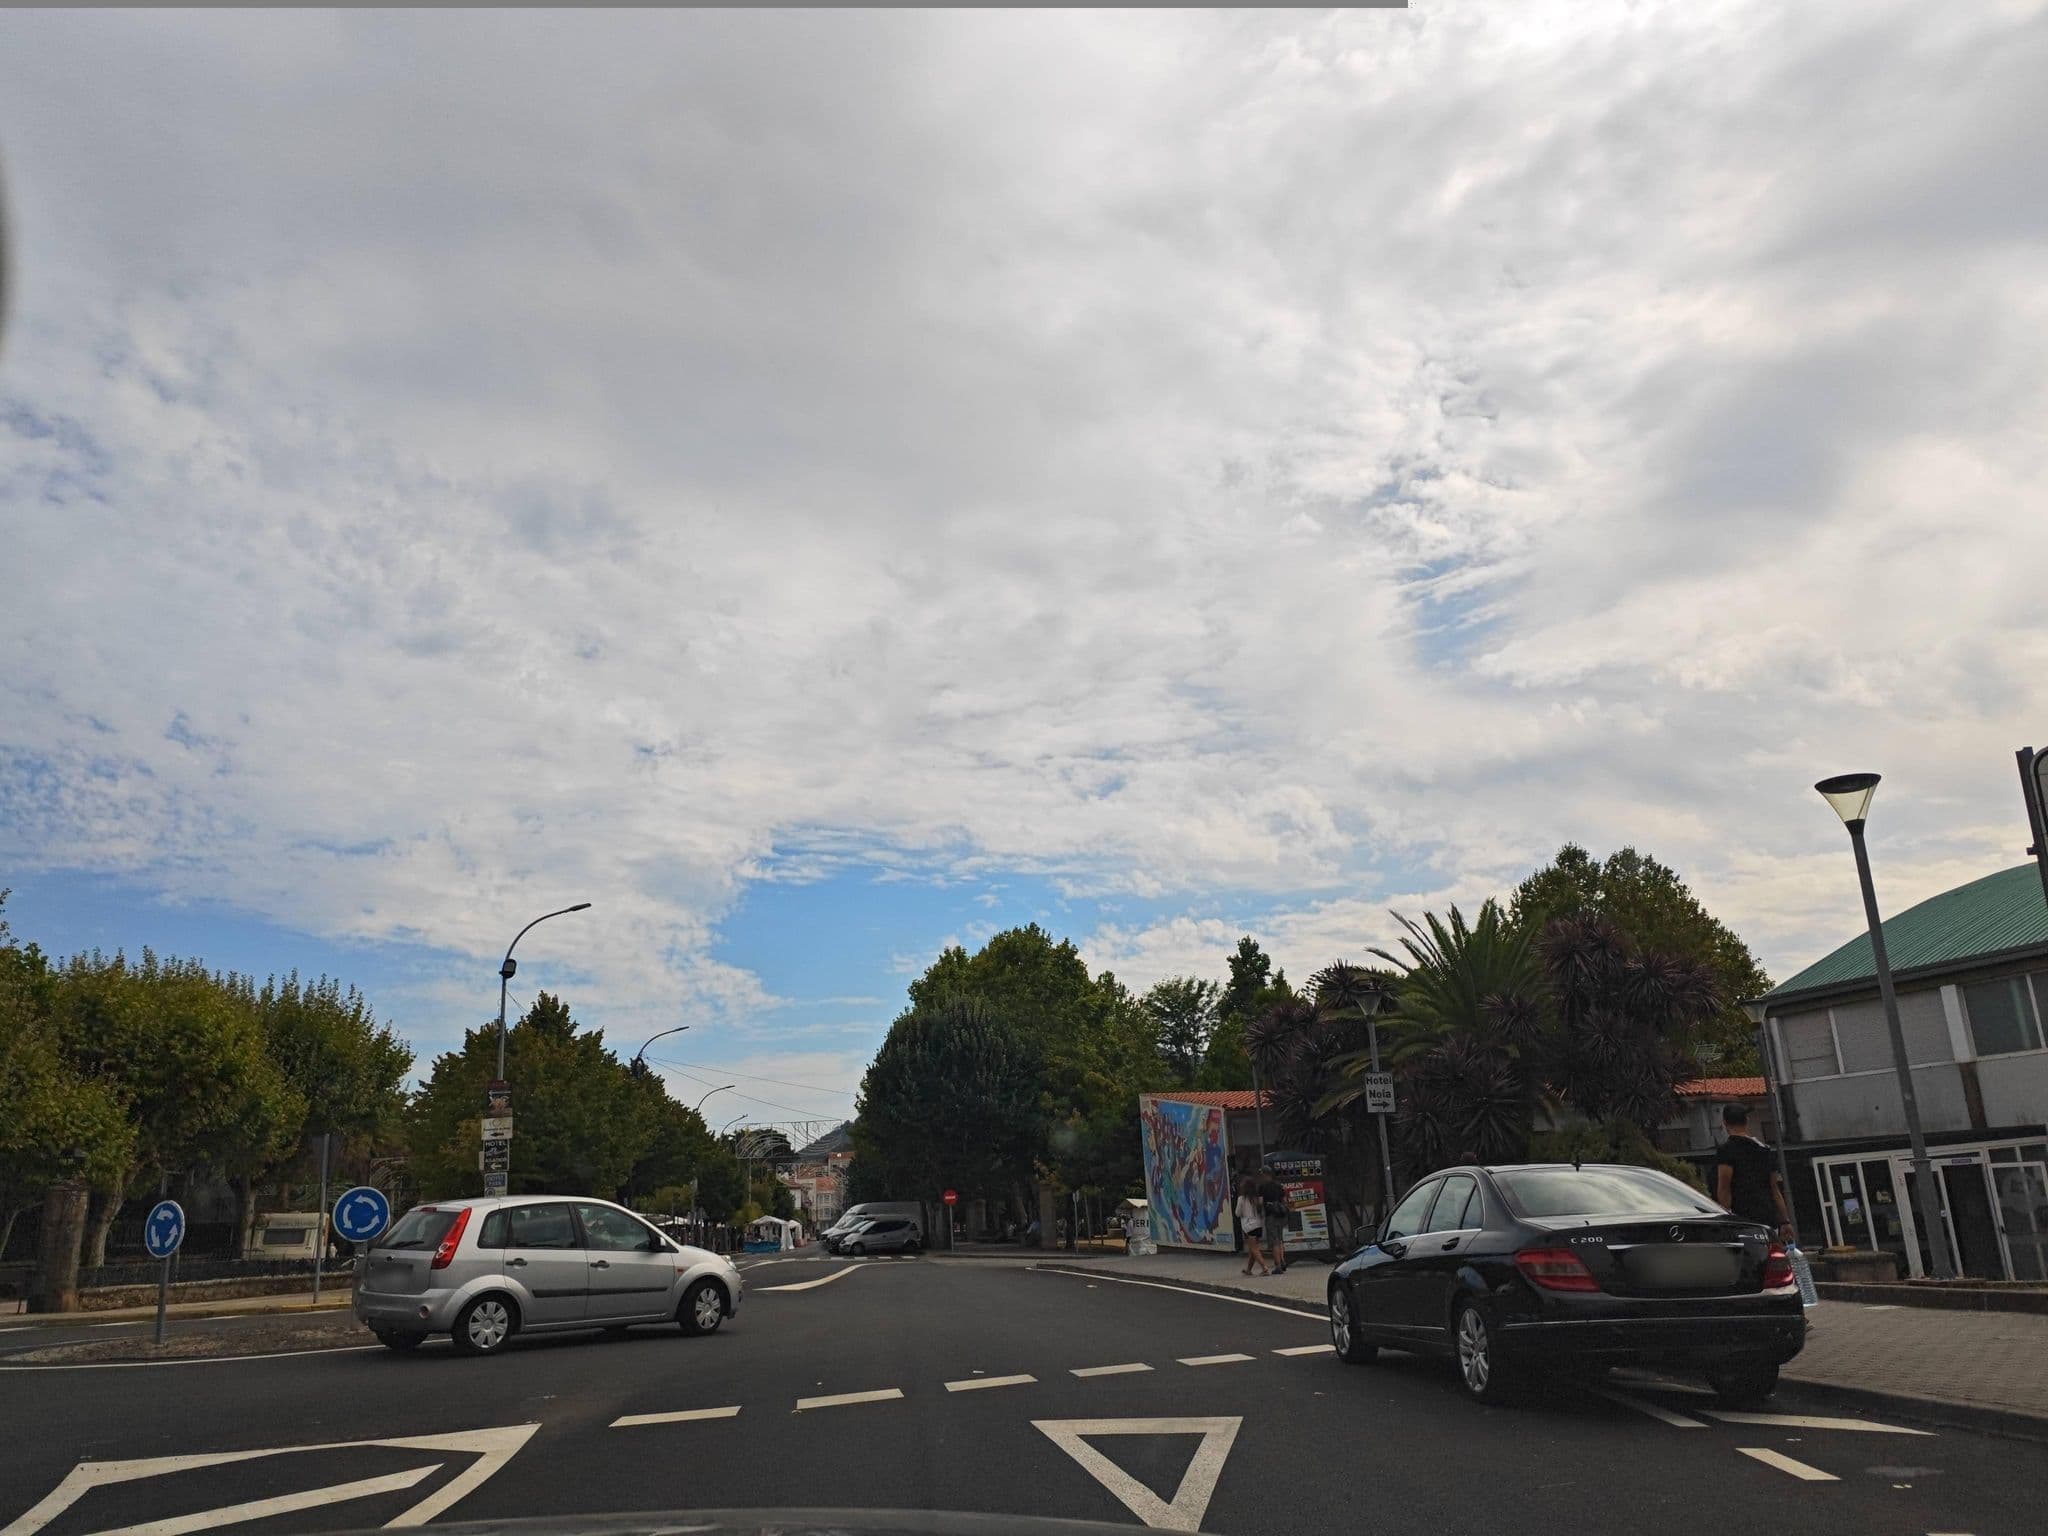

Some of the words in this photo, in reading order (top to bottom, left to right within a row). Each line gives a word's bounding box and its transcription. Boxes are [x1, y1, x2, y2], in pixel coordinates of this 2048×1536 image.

[1366, 1076, 1393, 1085] Hotel
[1369, 1089, 1392, 1099] Noia
[1580, 1236, 1604, 1244] 200
